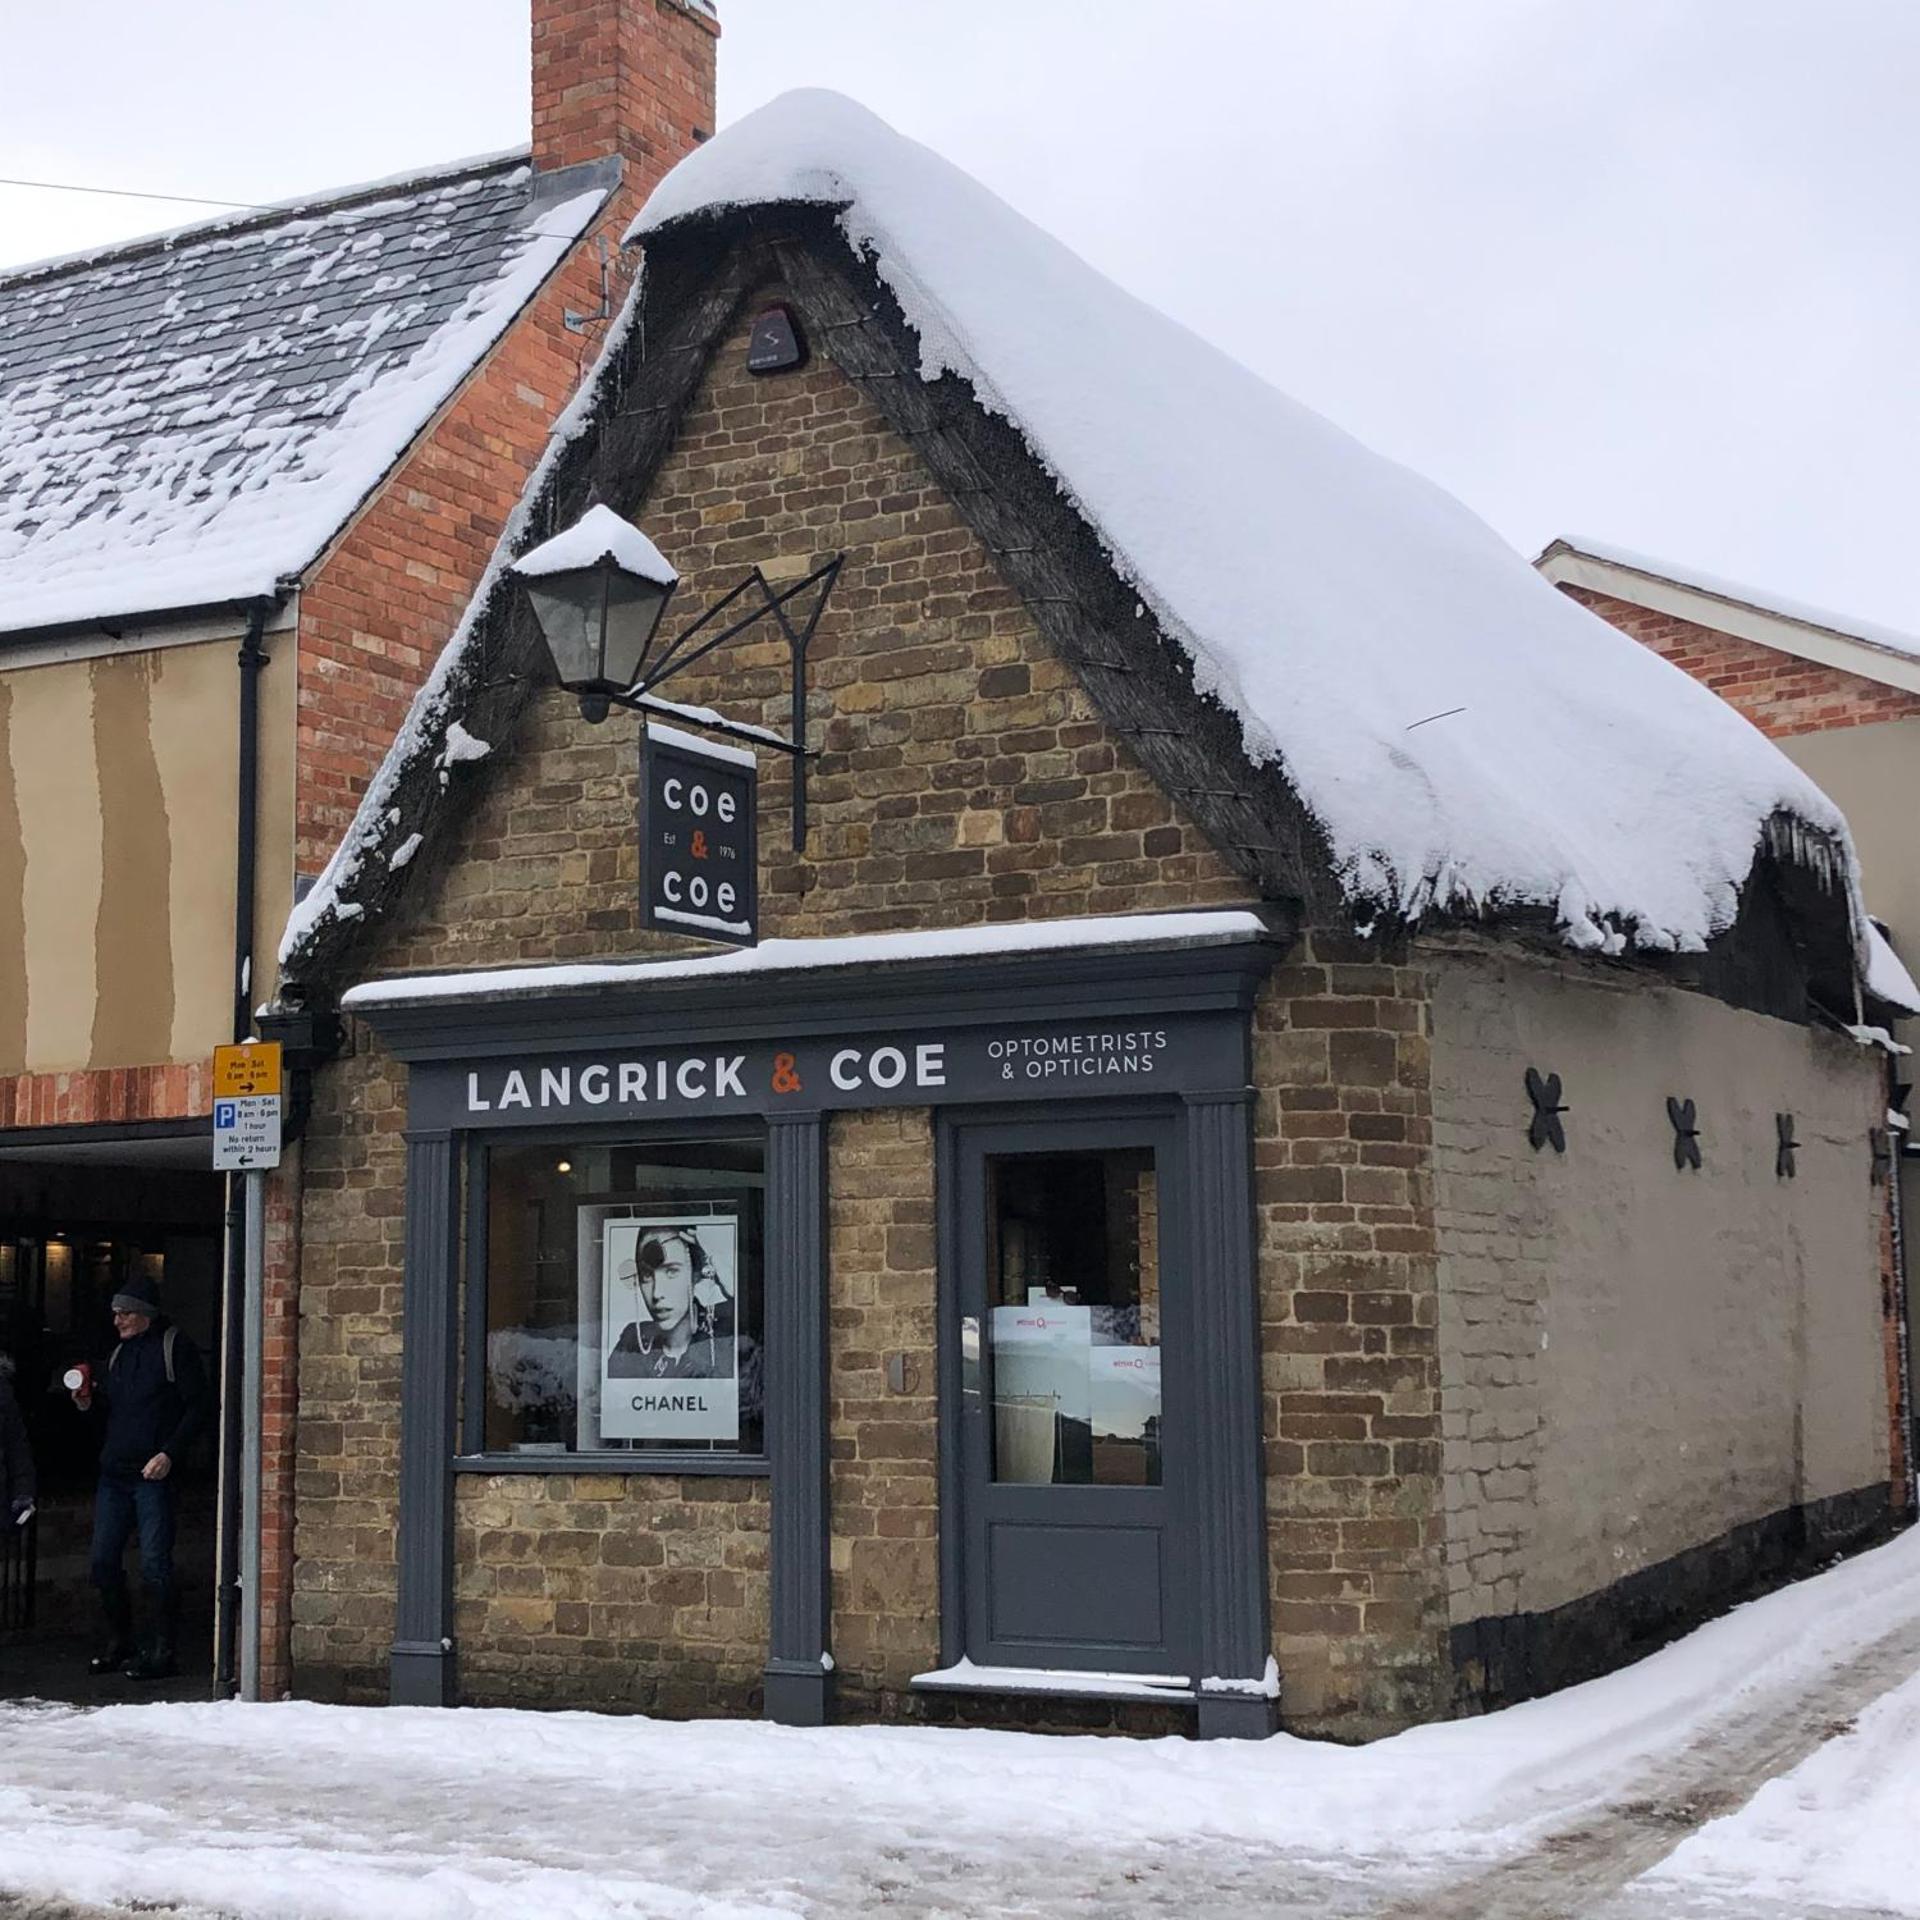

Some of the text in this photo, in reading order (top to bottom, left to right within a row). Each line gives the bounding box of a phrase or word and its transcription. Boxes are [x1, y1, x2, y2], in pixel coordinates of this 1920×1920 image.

[663, 778, 736, 823] coe
[663, 832, 676, 845] Est
[691, 830, 708, 859] &
[663, 871, 736, 913] coe
[987, 1031, 1167, 1058] OPTOMETRISTS
[467, 1044, 946, 1111] LANGRICK & COE
[1001, 1054, 1153, 1080] & OPTICIANS
[220, 1106, 233, 1127] P
[223, 1145, 245, 1153] within
[255, 1145, 277, 1153] hours
[228, 1135, 265, 1144] No return
[631, 1396, 709, 1412] CHANEL
